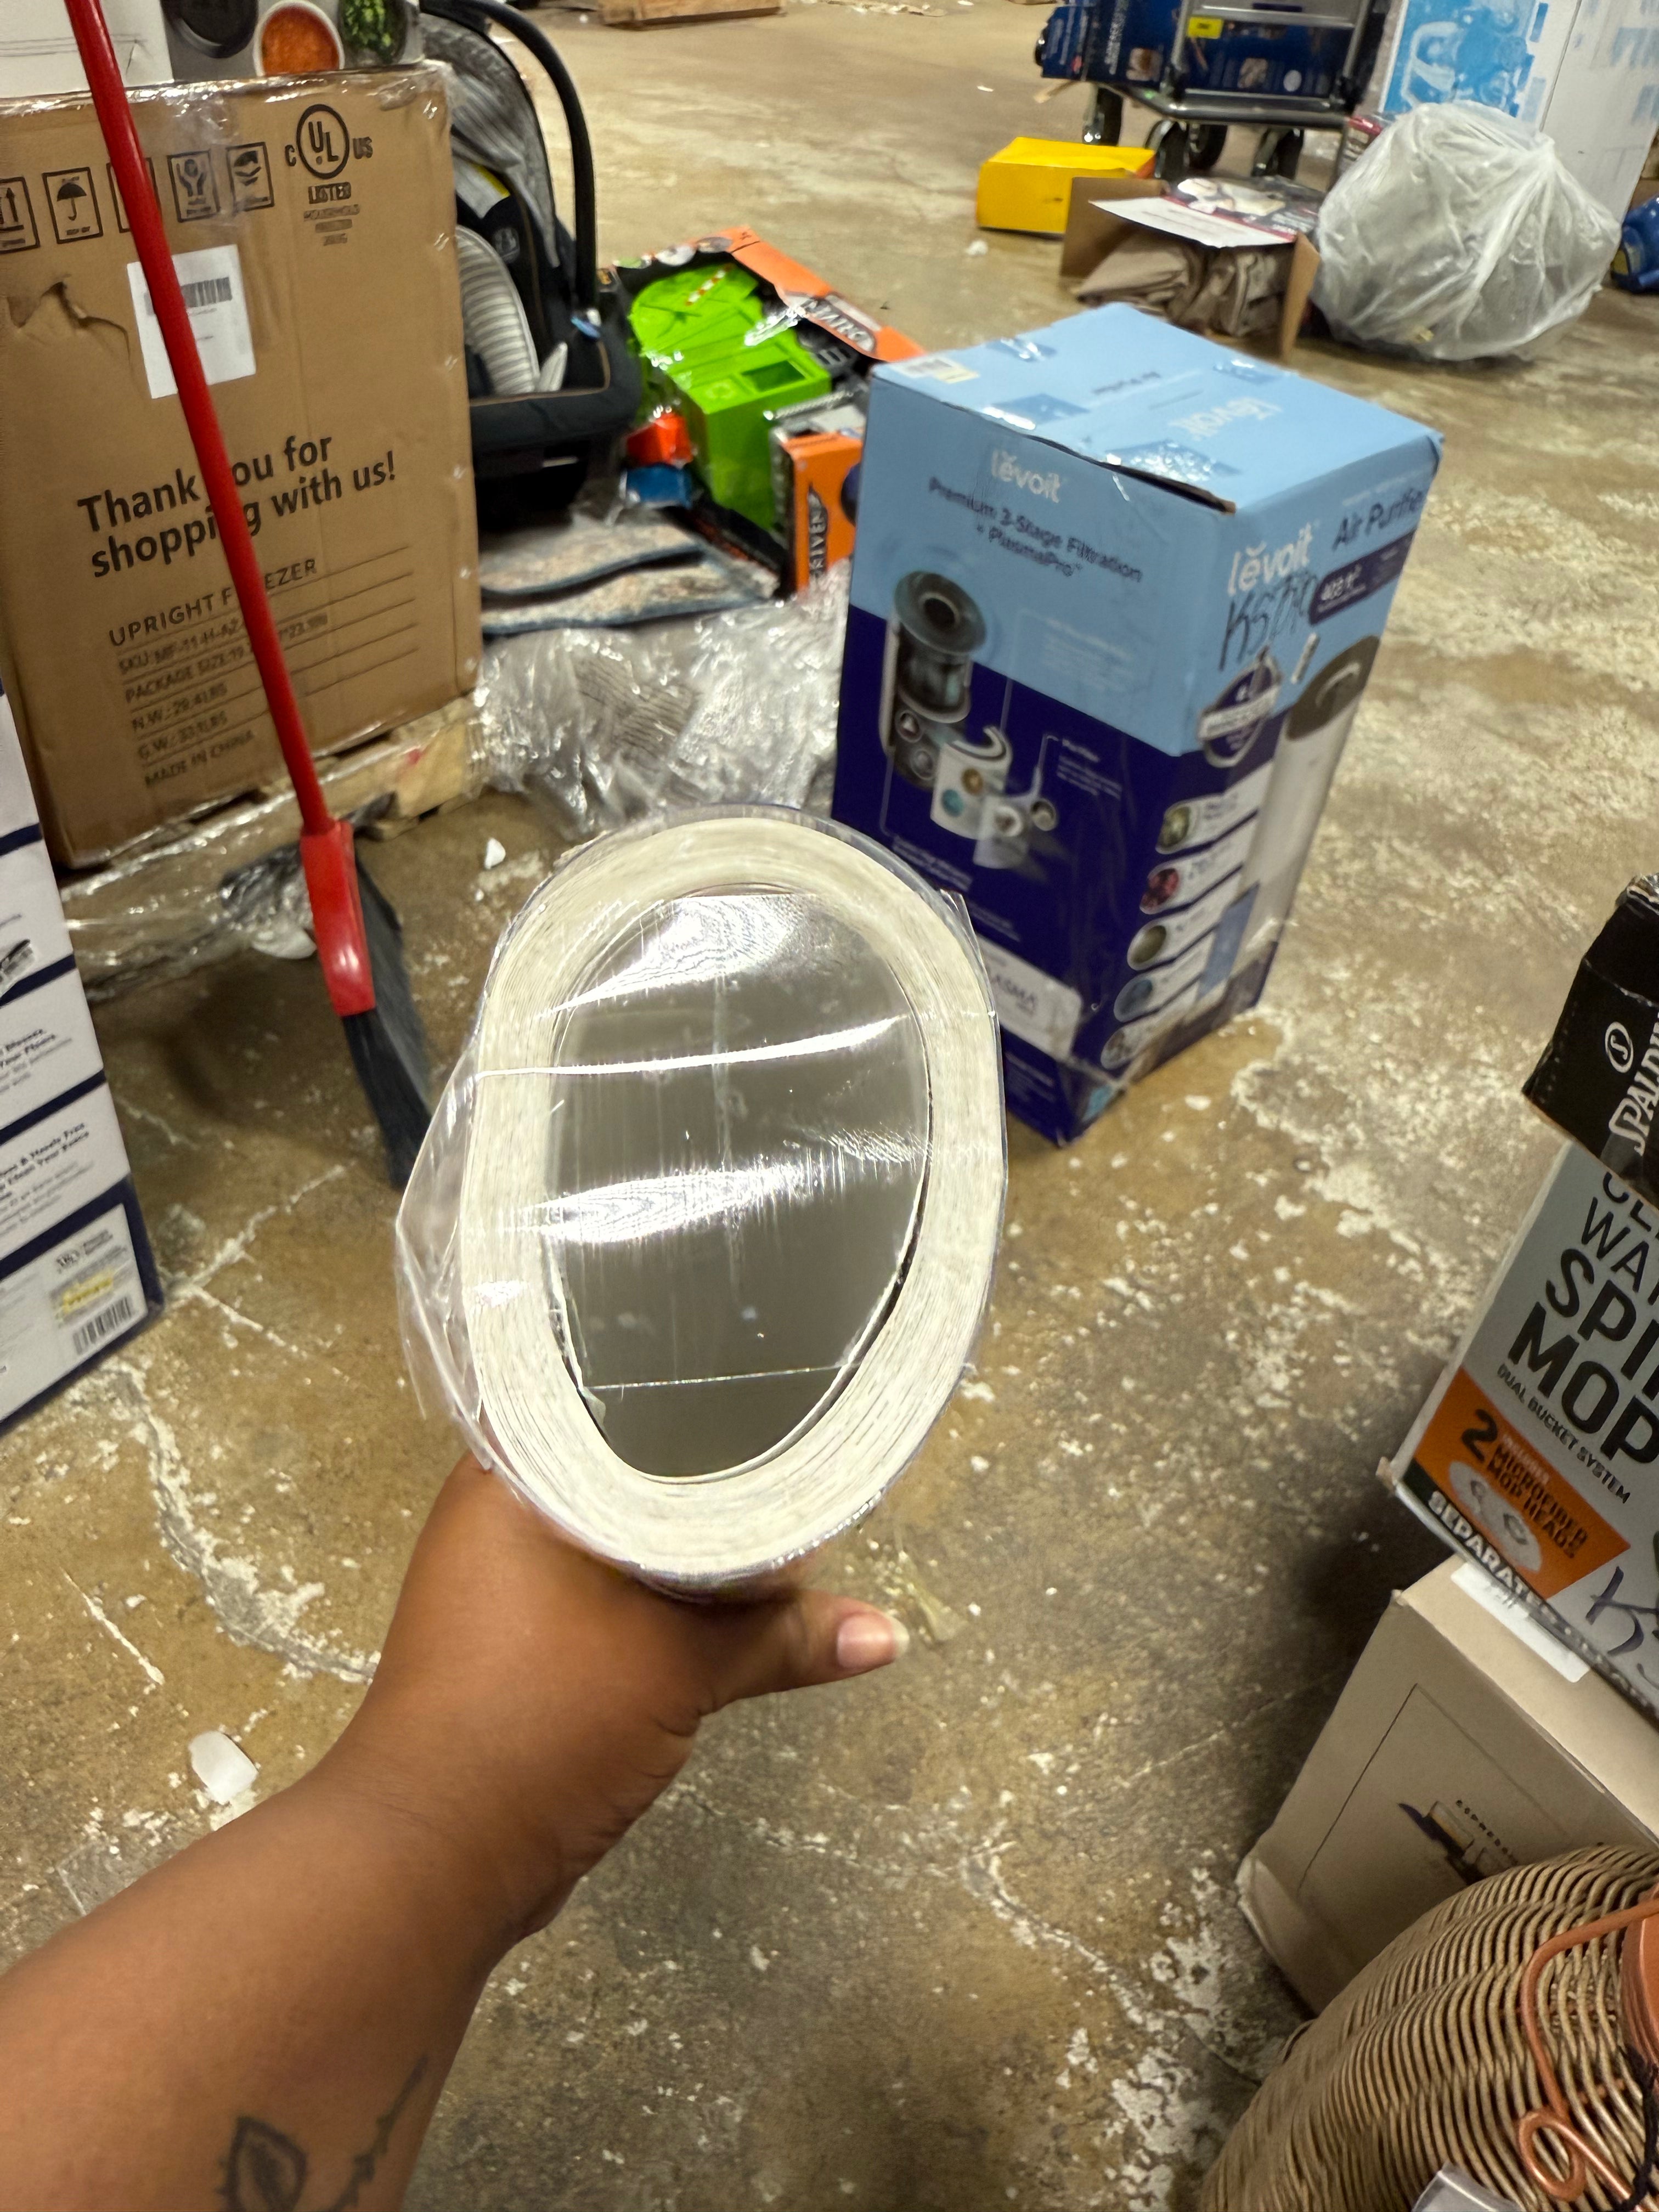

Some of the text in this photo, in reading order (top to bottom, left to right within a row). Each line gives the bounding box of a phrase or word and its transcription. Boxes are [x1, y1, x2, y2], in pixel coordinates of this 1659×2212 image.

[77, 467, 200, 532] Thank
[284, 435, 332, 471] for
[91, 450, 397, 578] shoppig with us!
[109, 558, 318, 647] UPRIGHT FEZER
[1508, 1301, 1659, 1464] MOP
[1462, 1408, 1498, 1464] 2
